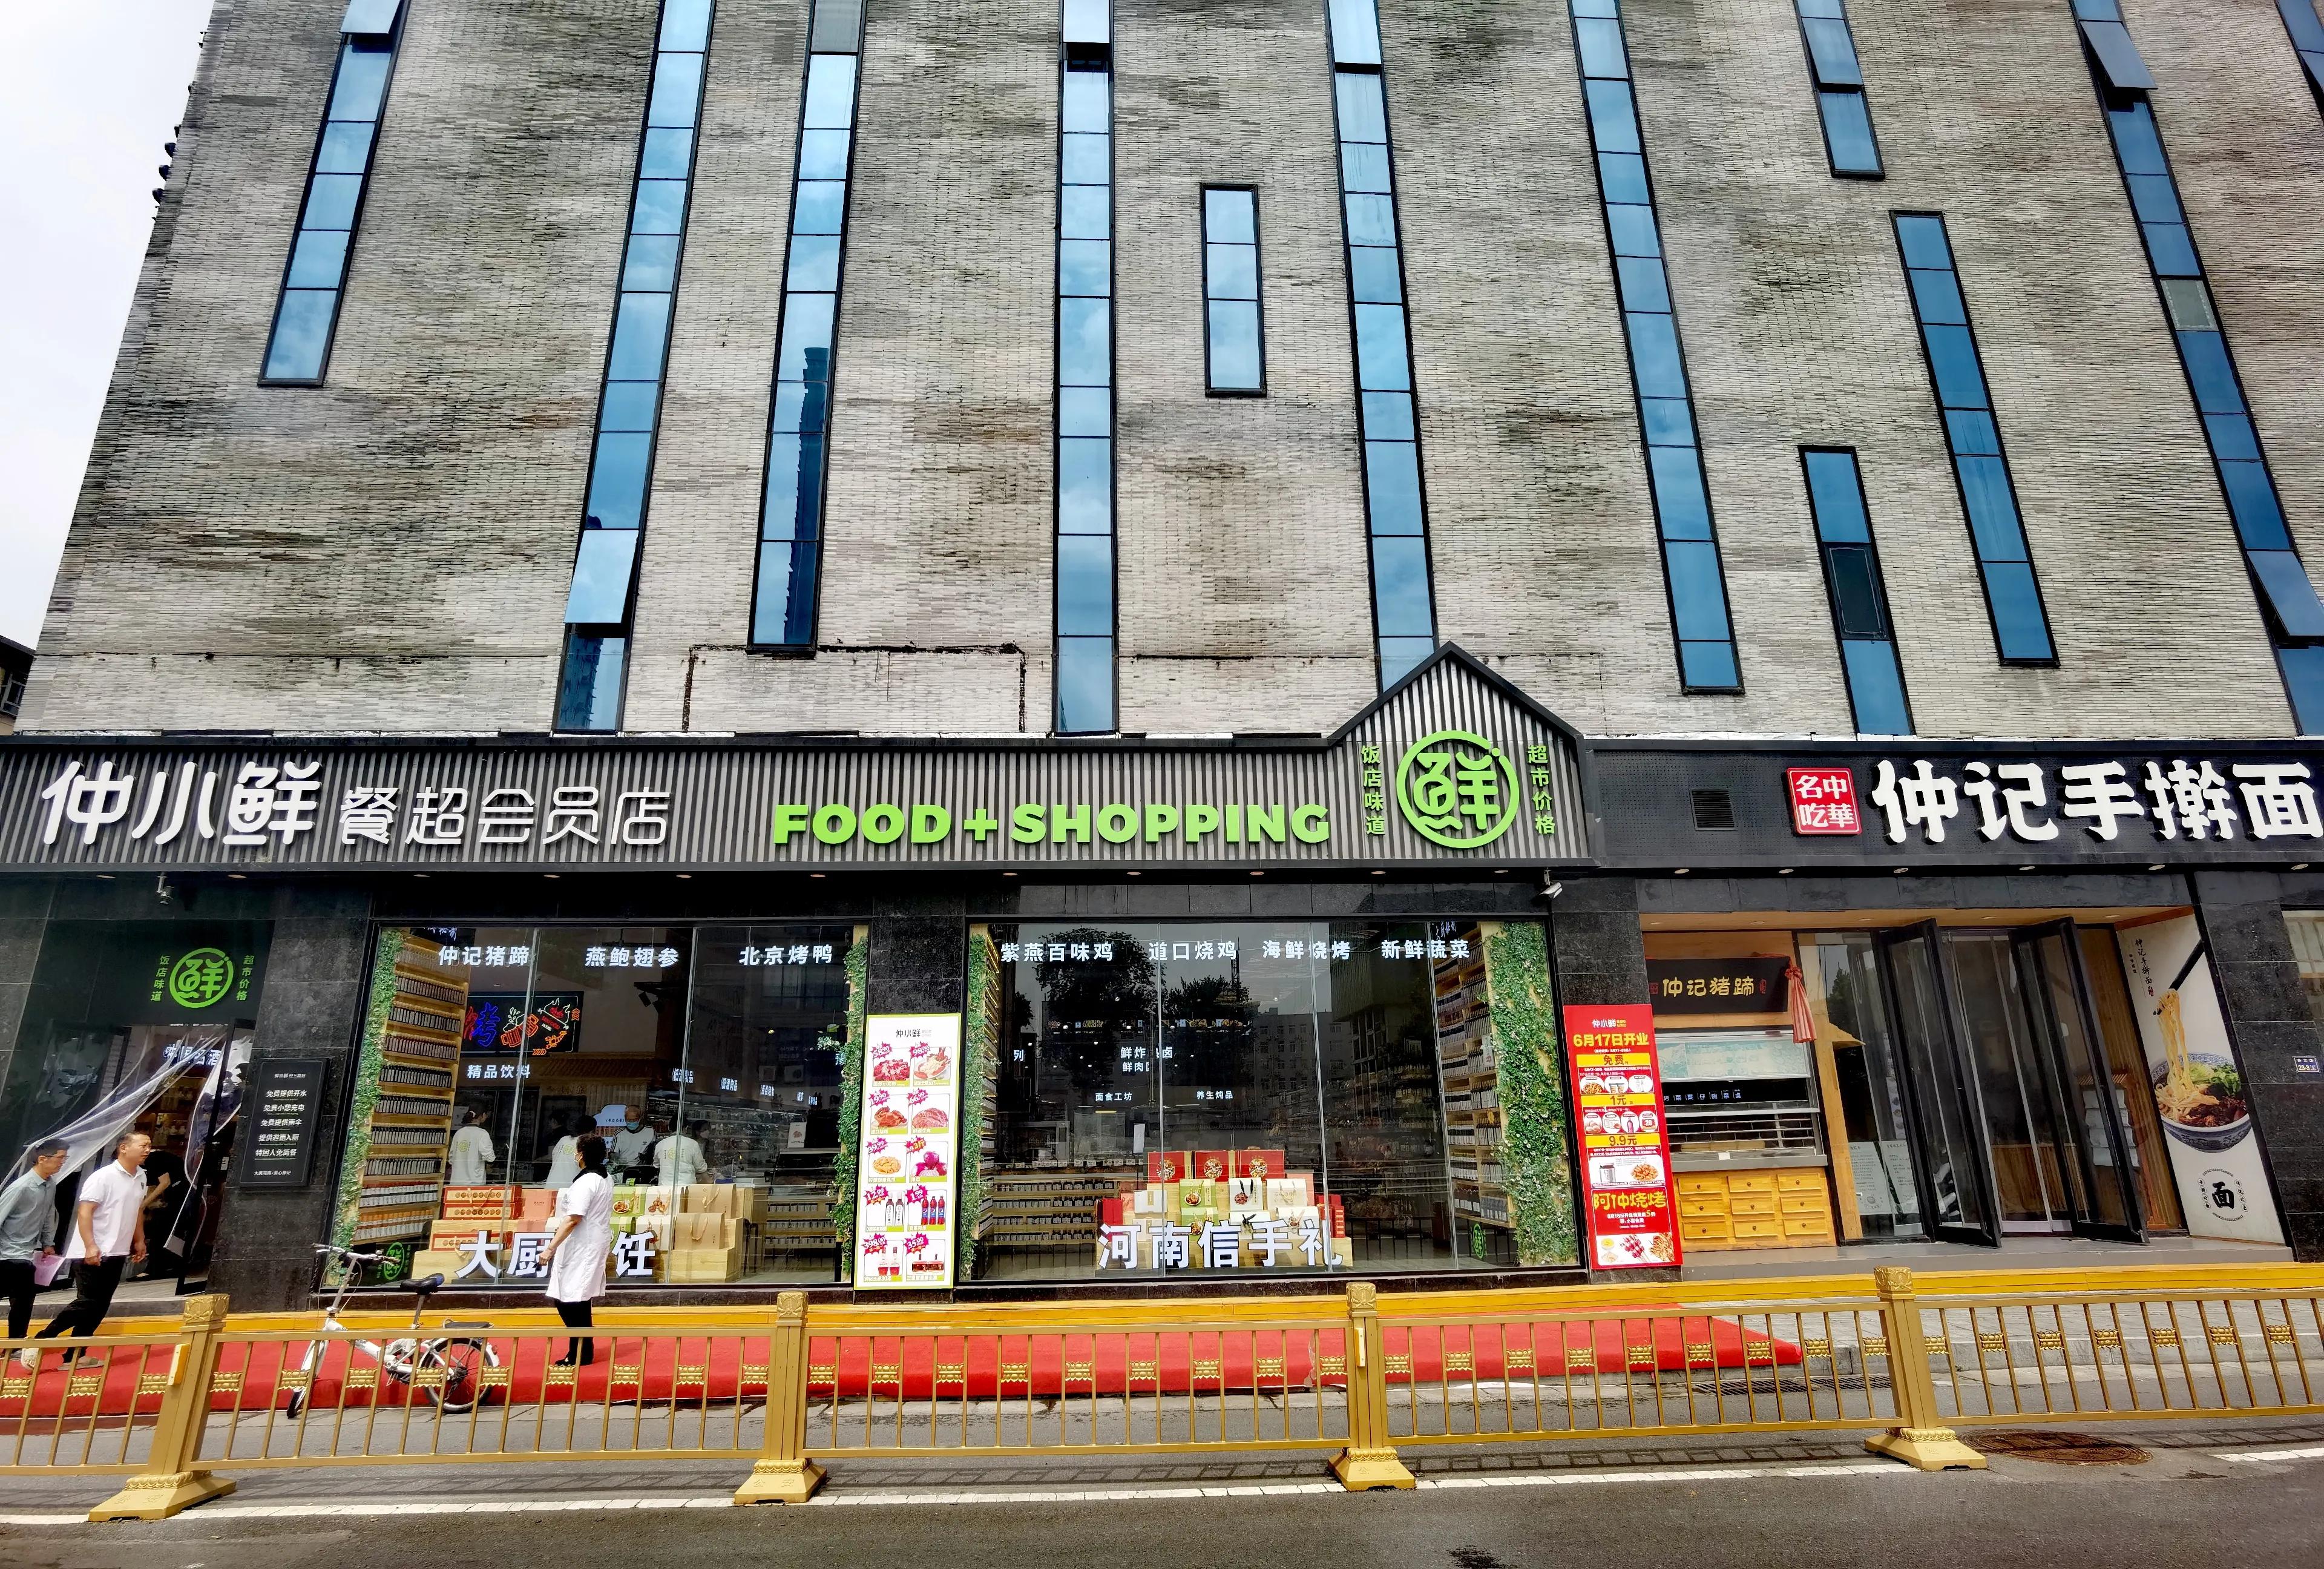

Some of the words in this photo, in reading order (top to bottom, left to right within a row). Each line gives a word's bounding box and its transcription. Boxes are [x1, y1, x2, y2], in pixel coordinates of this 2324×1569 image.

[1361, 745, 1386, 835] 饭店味道
[1527, 745, 1555, 835] 超市价格
[42, 760, 322, 845] 仲小鲜
[340, 786, 672, 845] 餐超会员店
[1871, 760, 2324, 843] 仲记手擀面
[773, 804, 951, 845] FOOD
[1010, 803, 1330, 845] SHOPPING
[438, 946, 530, 966] 仲记猪蹄
[585, 946, 680, 968] 燕鲍翅参
[739, 944, 833, 966] 北京烤鸭
[1000, 941, 1114, 962] 紫燕百味鸡
[1149, 940, 1238, 961] 道口烧鸡
[1262, 939, 1351, 960] 海鲜烧烤
[1380, 939, 1471, 960] 新鲜蔬菜
[151, 955, 171, 1002] 饭店味道
[236, 955, 255, 1001] 超市价格
[1663, 976, 1754, 998] 仲记猪蹄
[896, 1029, 921, 1038] 仲小鲜
[1574, 1033, 1649, 1047] 6月17日开业
[1604, 1054, 1624, 1065] 免费
[467, 1064, 531, 1079] 精品饮料
[1095, 1092, 1132, 1102] 面食工坊
[1196, 1090, 1233, 1100] 养生炖品
[1610, 1094, 1627, 1106] 1元
[1609, 1135, 1638, 1146] 9.9元
[1593, 1191, 1666, 1211] 阿仲烧烤
[2211, 1181, 2234, 1209] 面
[456, 1231, 657, 1278] 大厨饪
[1097, 1219, 1344, 1269] 河南信手礼
